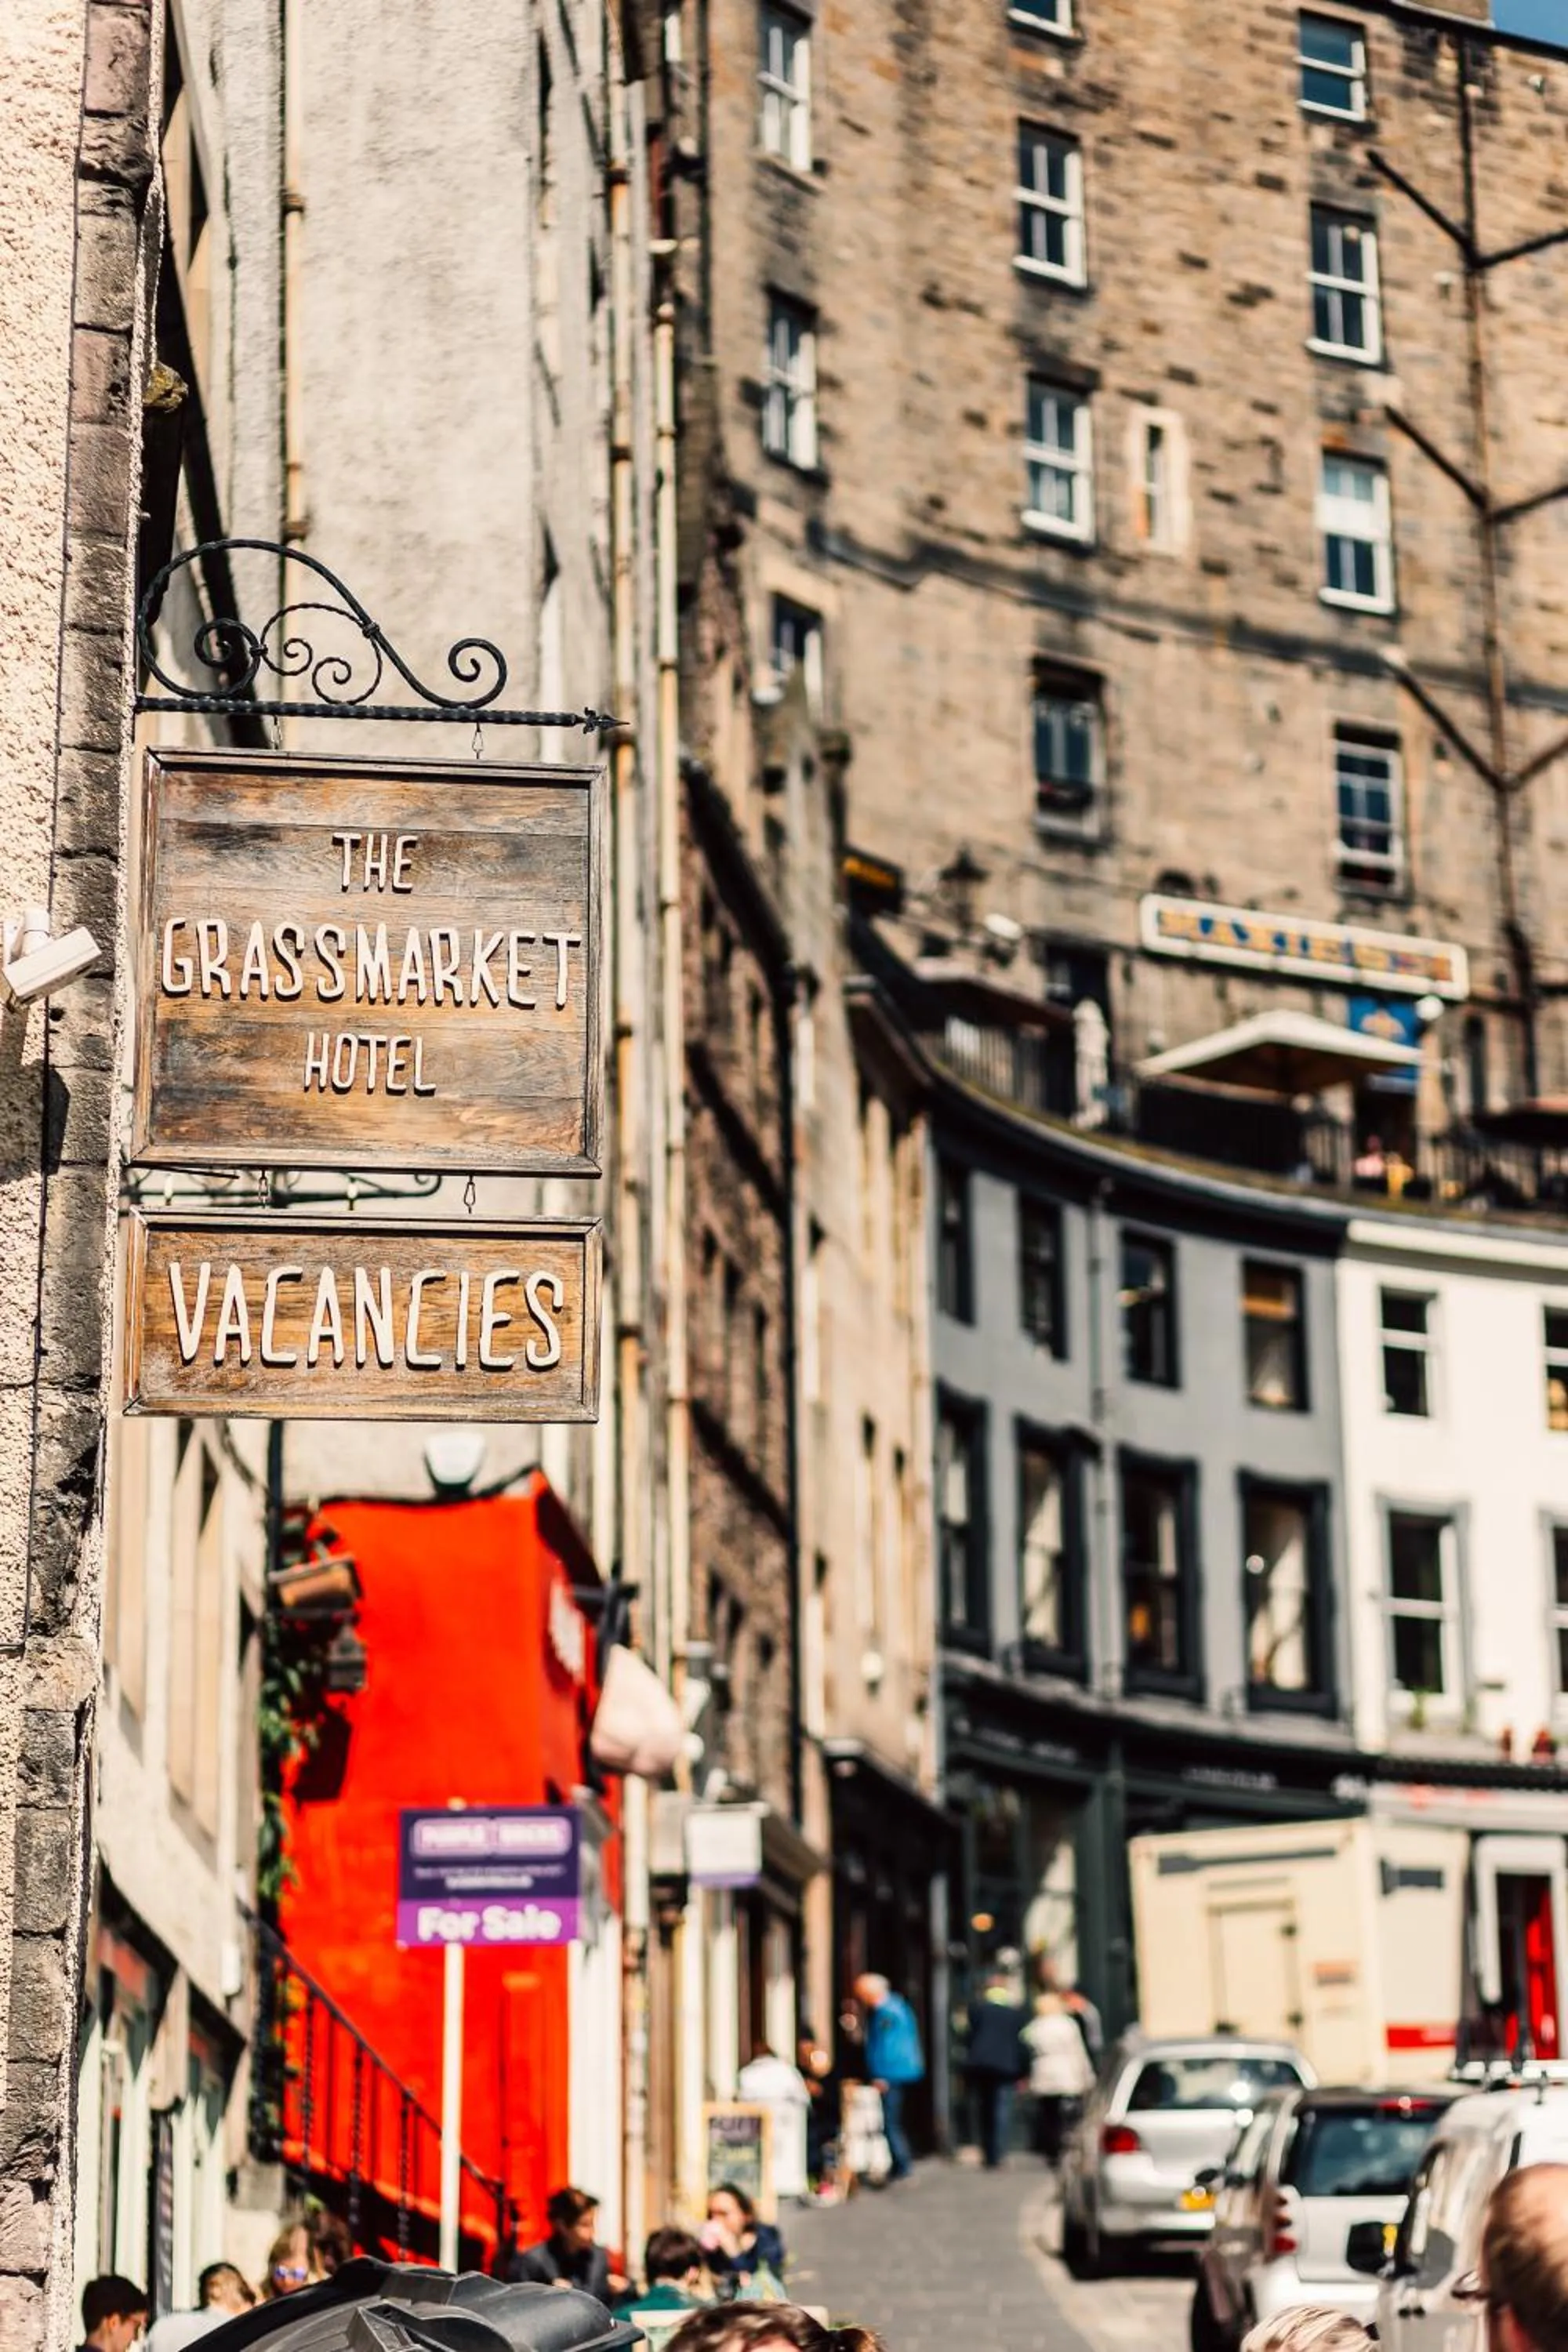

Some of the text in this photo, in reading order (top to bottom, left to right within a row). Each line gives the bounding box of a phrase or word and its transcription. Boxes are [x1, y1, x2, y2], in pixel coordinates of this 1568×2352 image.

[332, 832, 418, 893] THE
[161, 917, 582, 1010] GRASSMARKET
[303, 1031, 437, 1093] HOTEL
[168, 1261, 563, 1370] VACANCIES
[417, 1904, 562, 1942] For Sale
